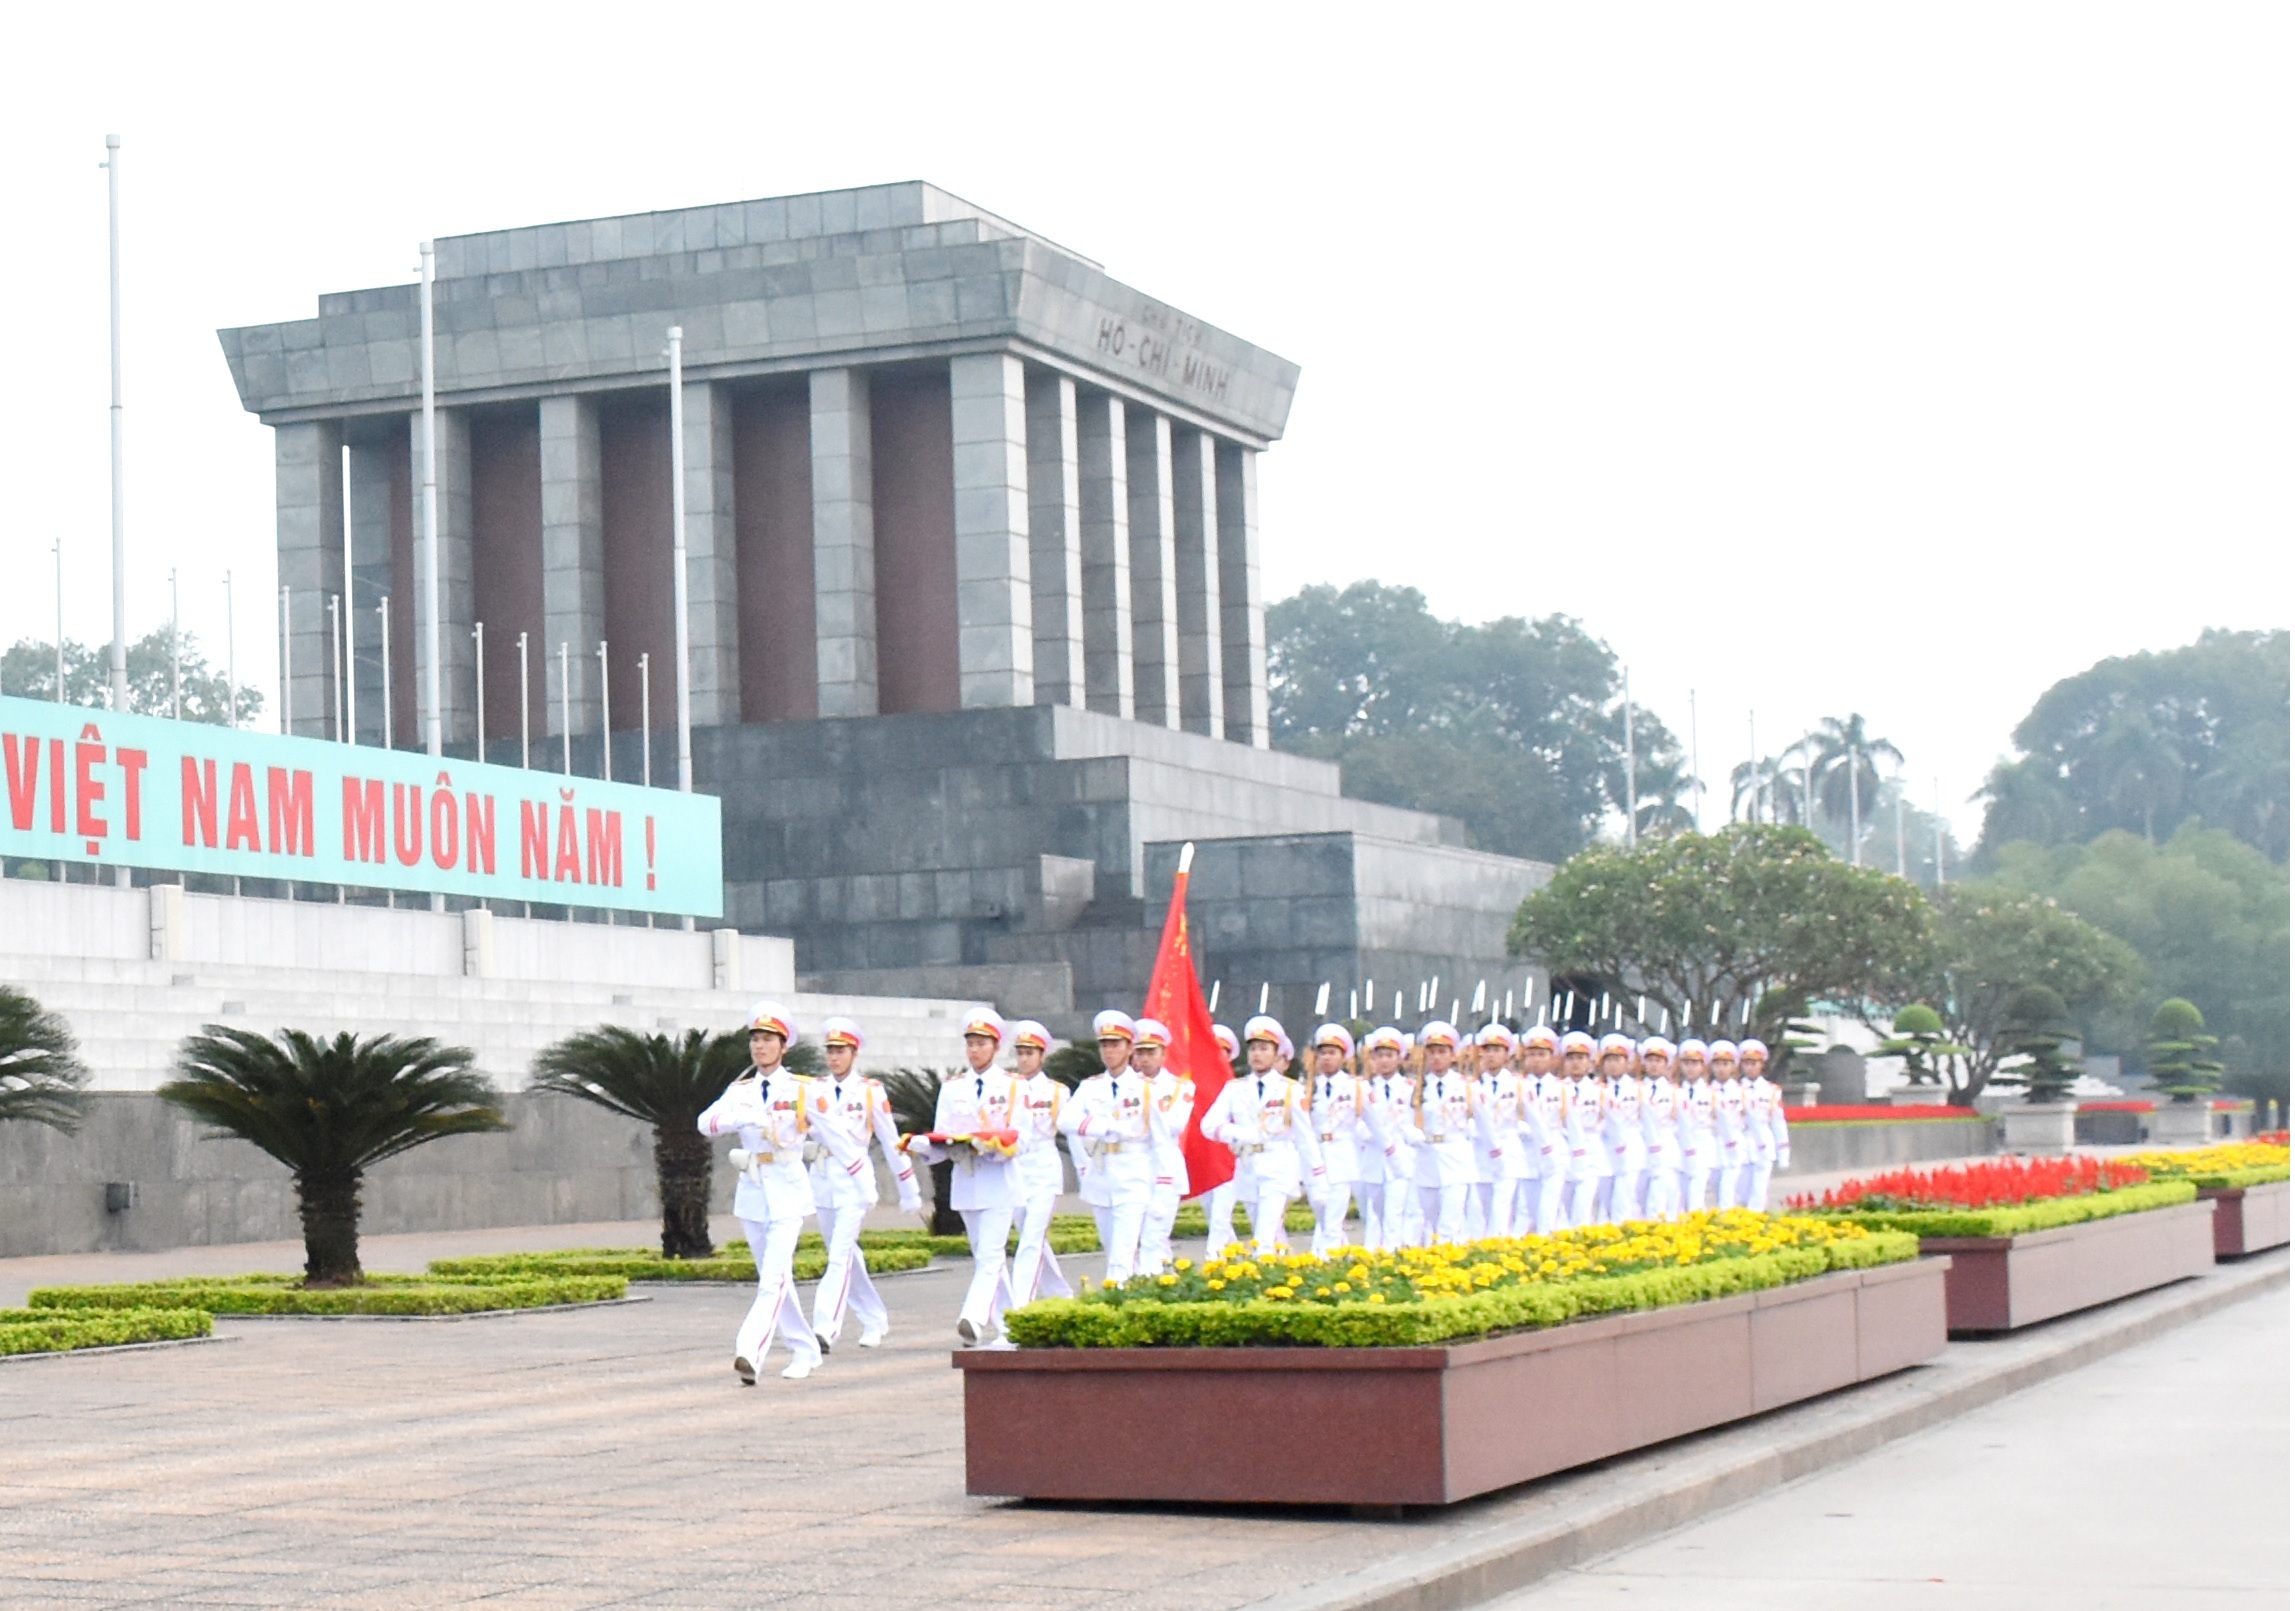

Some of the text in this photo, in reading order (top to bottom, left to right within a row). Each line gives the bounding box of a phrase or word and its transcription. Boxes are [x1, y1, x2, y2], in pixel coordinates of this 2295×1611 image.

[2, 722, 147, 856] VIỆT
[182, 757, 314, 857] NAM
[343, 771, 496, 875] MUÔN
[521, 787, 622, 887] NĂM
